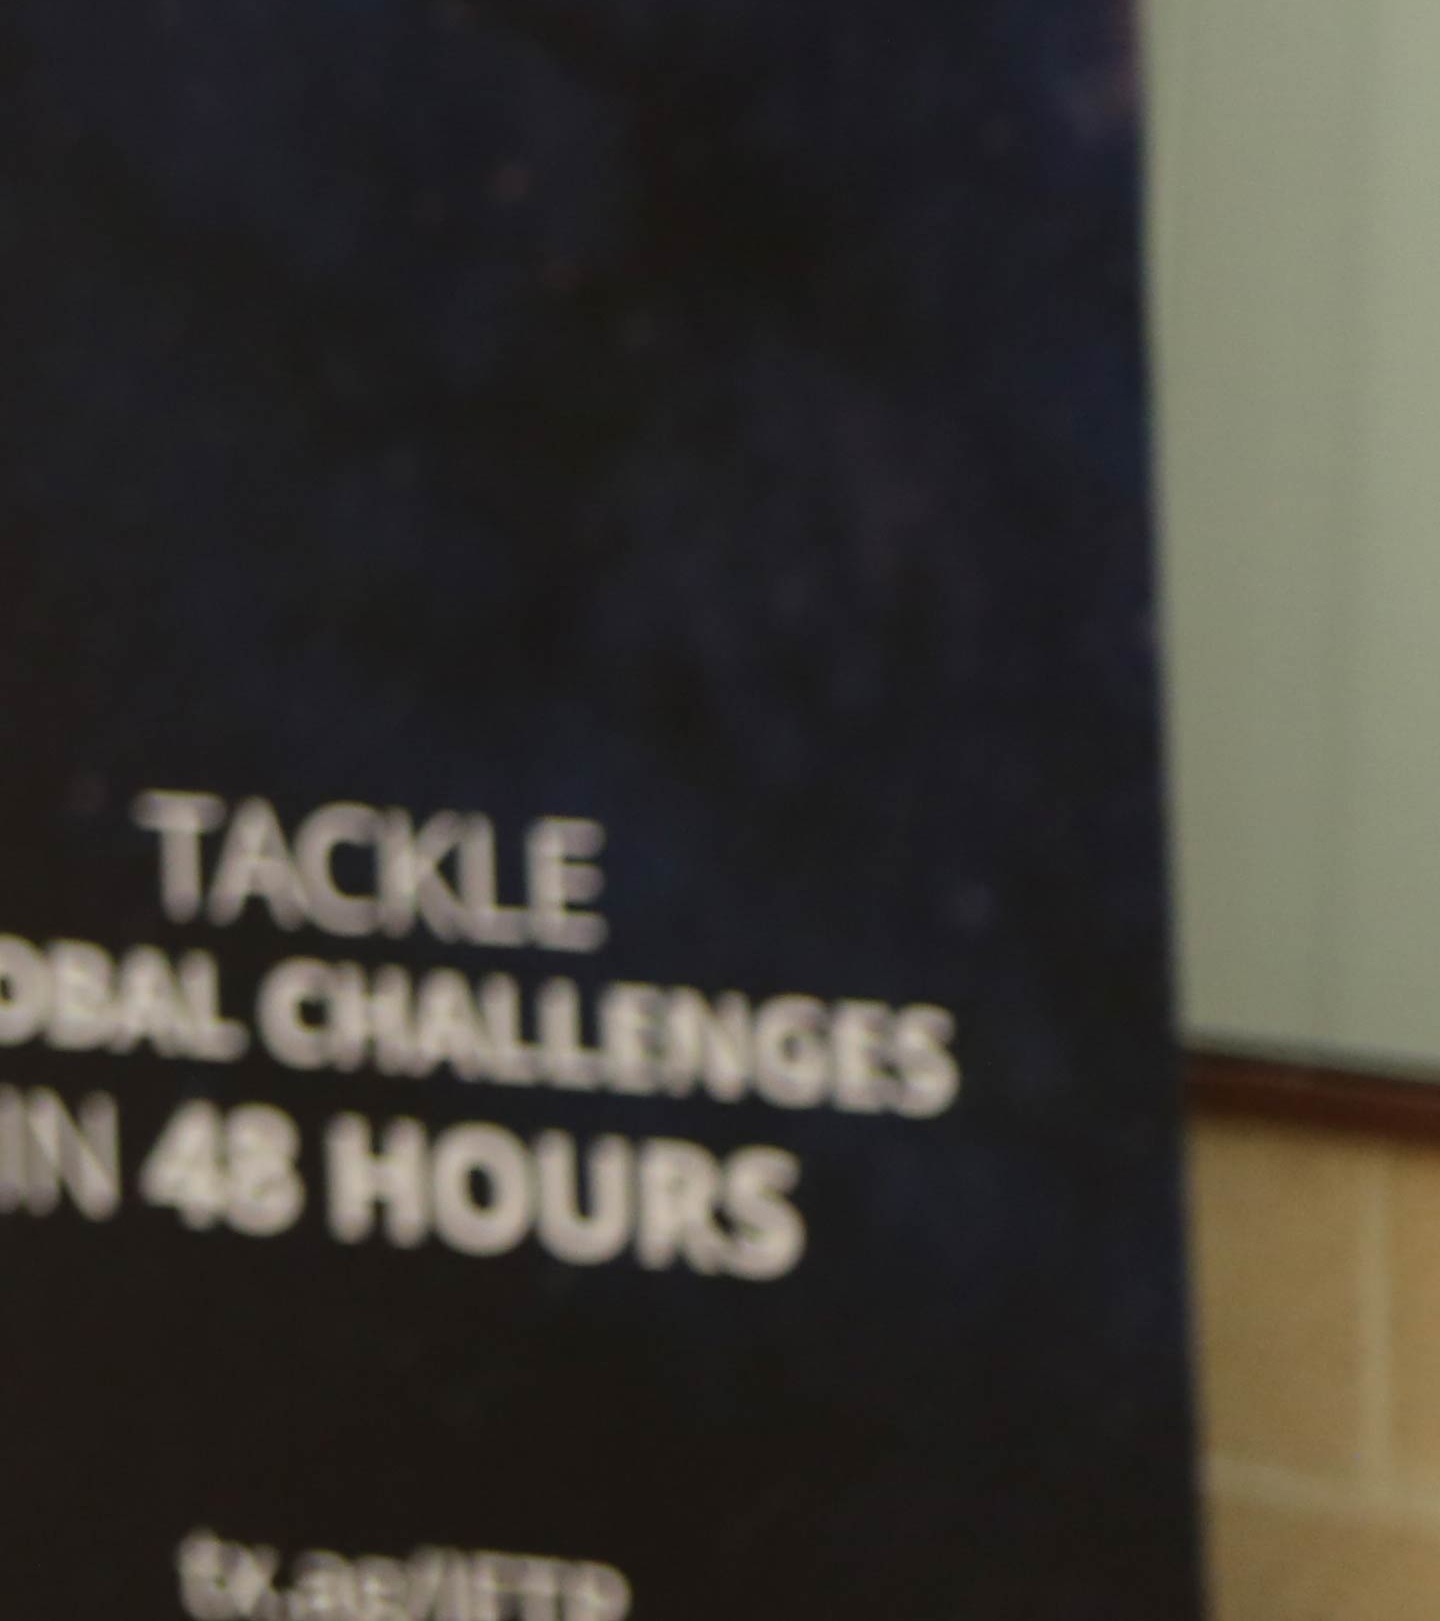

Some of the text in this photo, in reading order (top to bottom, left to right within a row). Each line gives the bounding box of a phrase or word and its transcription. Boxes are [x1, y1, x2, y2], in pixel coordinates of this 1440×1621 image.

[135, 790, 608, 955] TACKLE
[257, 956, 962, 1120] CHALLENGES
[139, 1100, 306, 1237] 48
[325, 1113, 807, 1282] HOURS
